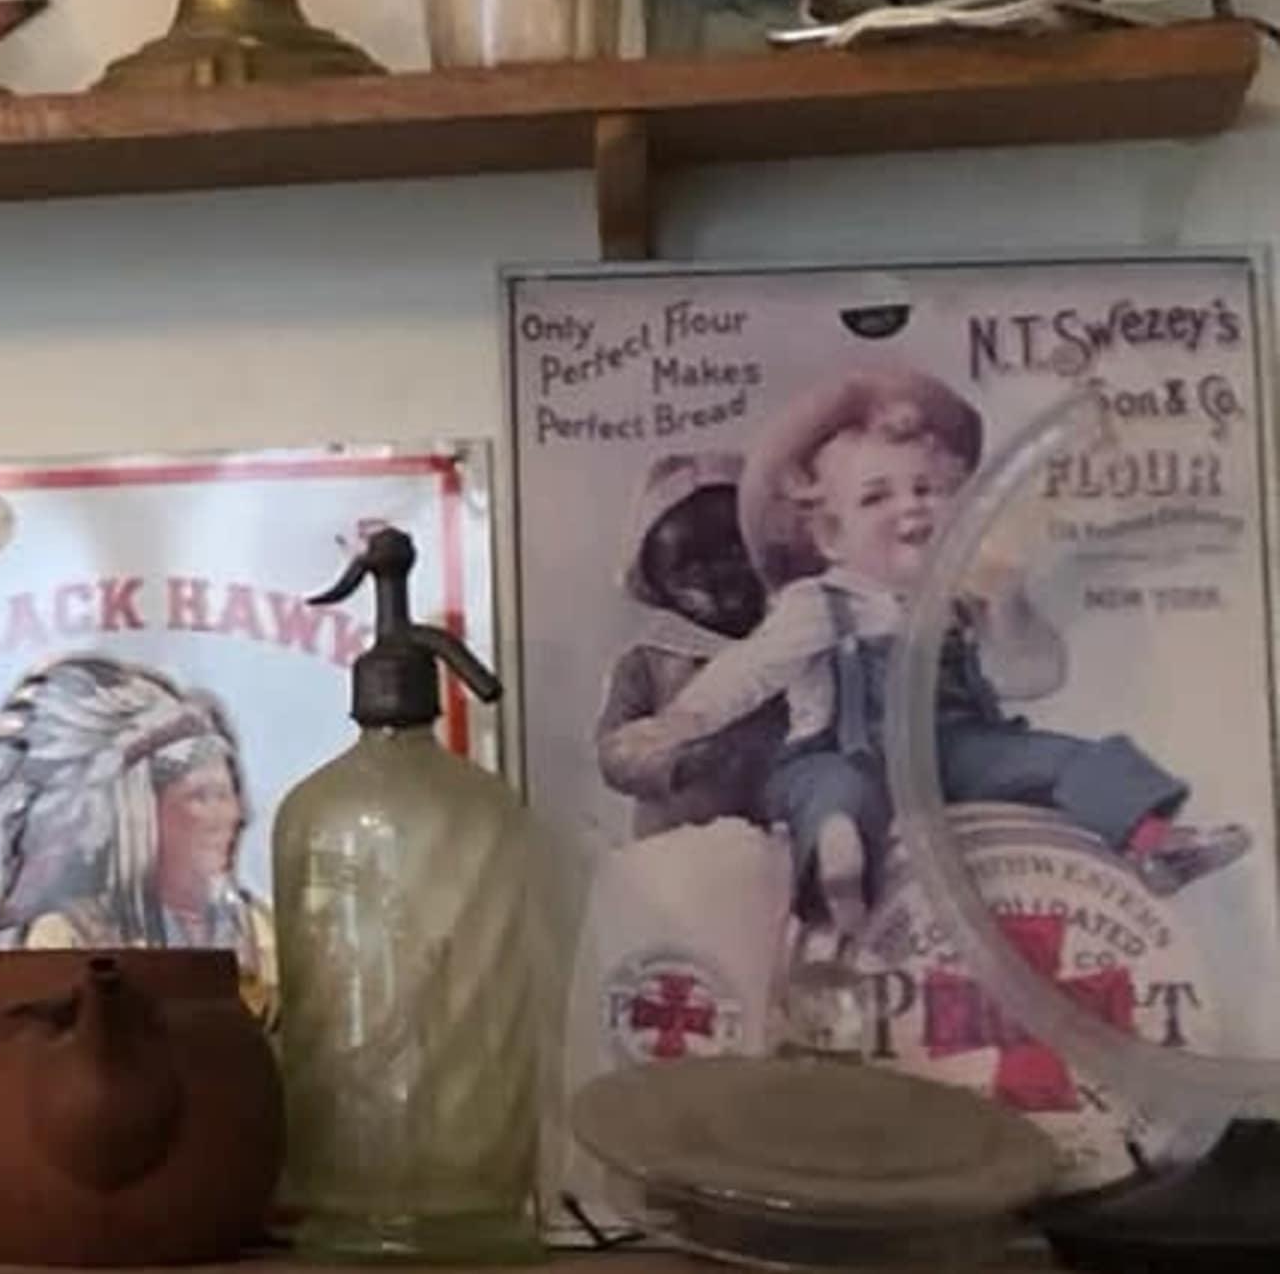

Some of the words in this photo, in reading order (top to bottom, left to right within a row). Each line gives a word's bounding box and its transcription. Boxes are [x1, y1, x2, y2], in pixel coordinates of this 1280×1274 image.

[521, 313, 596, 351] Only
[651, 356, 762, 395] Makes
[653, 388, 747, 437] Bread
